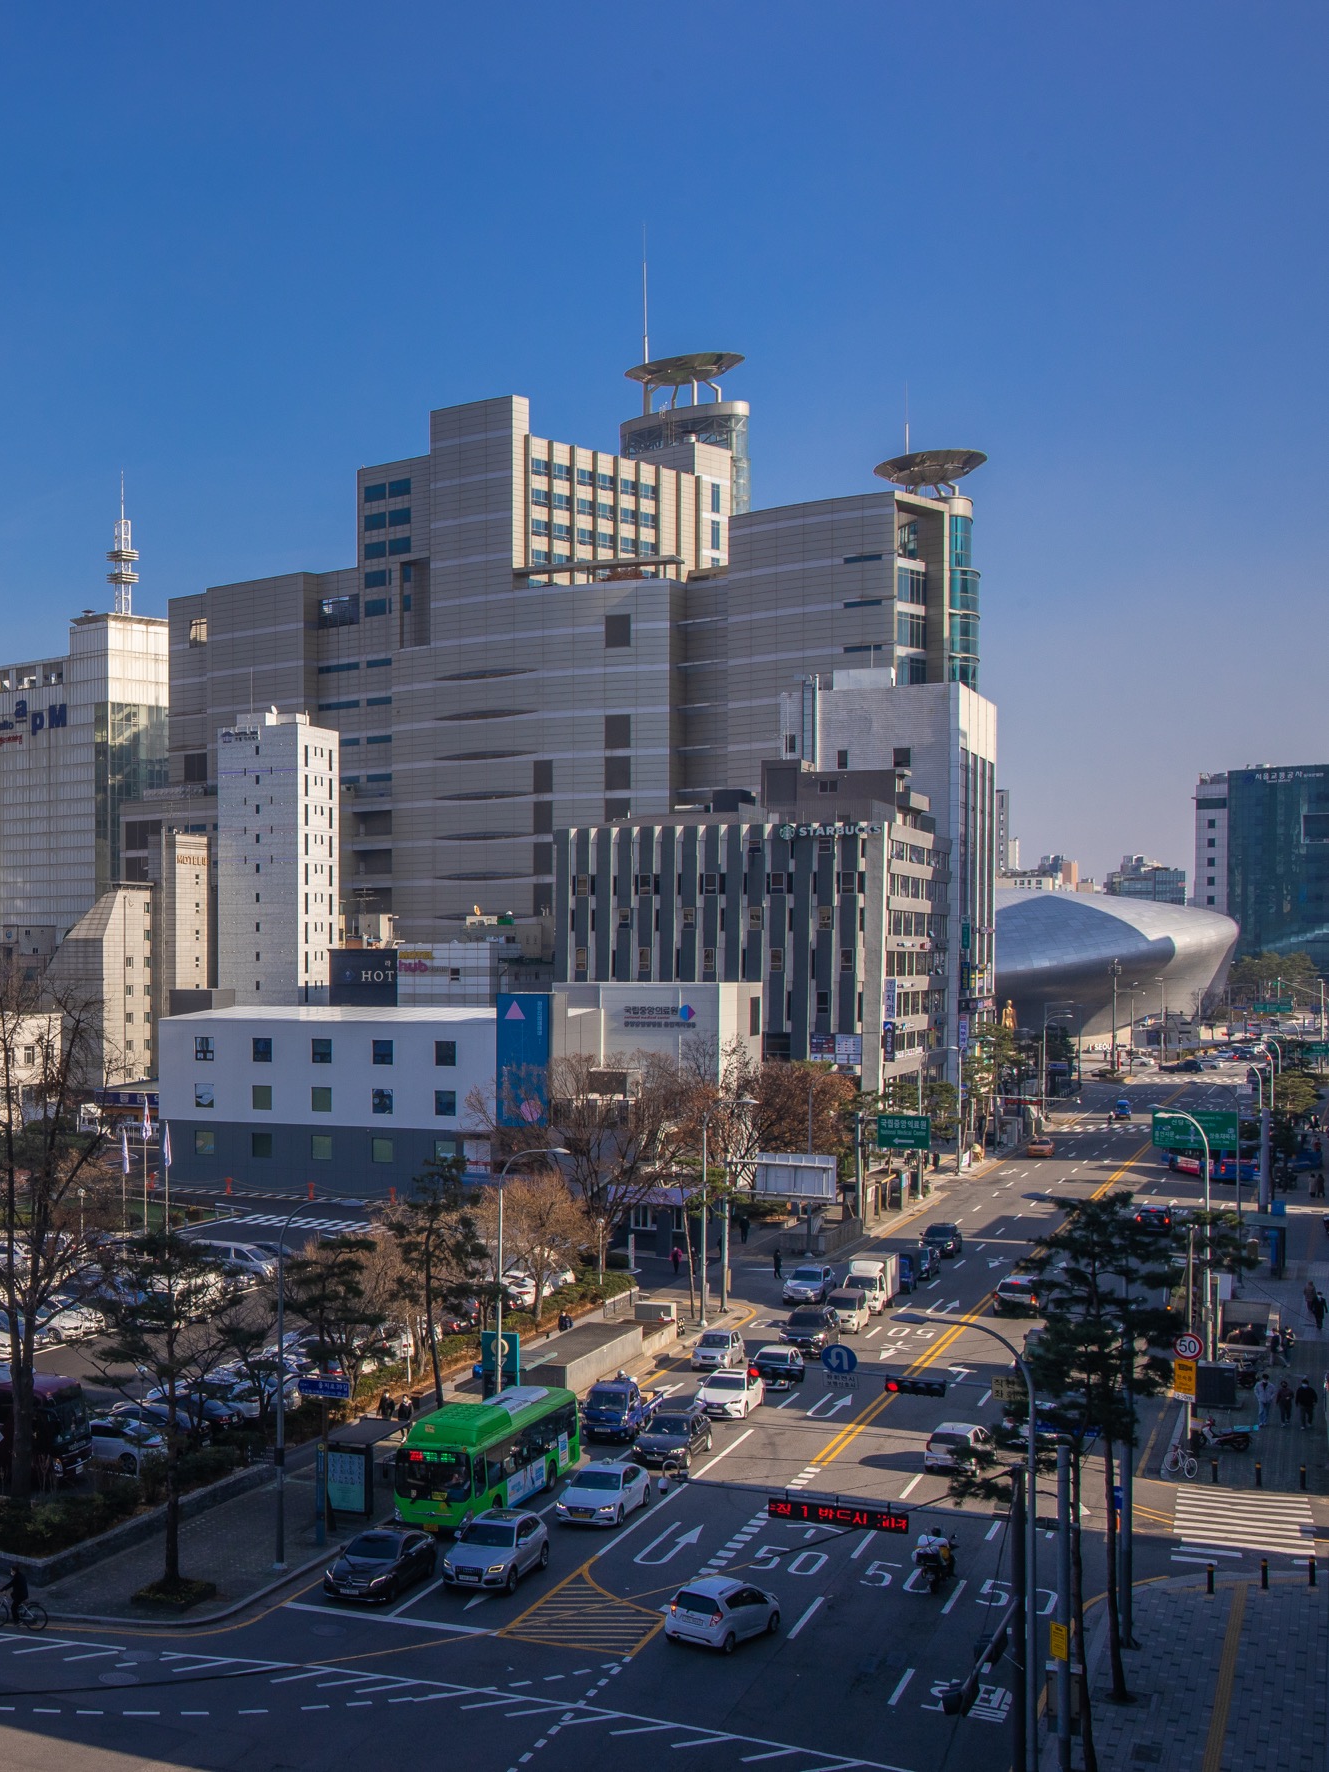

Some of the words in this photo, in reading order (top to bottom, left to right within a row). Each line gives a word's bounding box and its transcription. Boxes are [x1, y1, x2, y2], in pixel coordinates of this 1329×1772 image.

[798, 825, 882, 837] STARBUCKS
[398, 959, 429, 973] hub
[623, 1006, 679, 1015] 국립중앙의료원
[881, 1118, 927, 1129] 국립중앙의료원
[887, 1327, 937, 1339] 50
[1179, 1339, 1197, 1354] 50
[318, 1381, 348, 1392] 을지로39길
[818, 1507, 867, 1525] 반드시
[749, 1546, 829, 1575] 50
